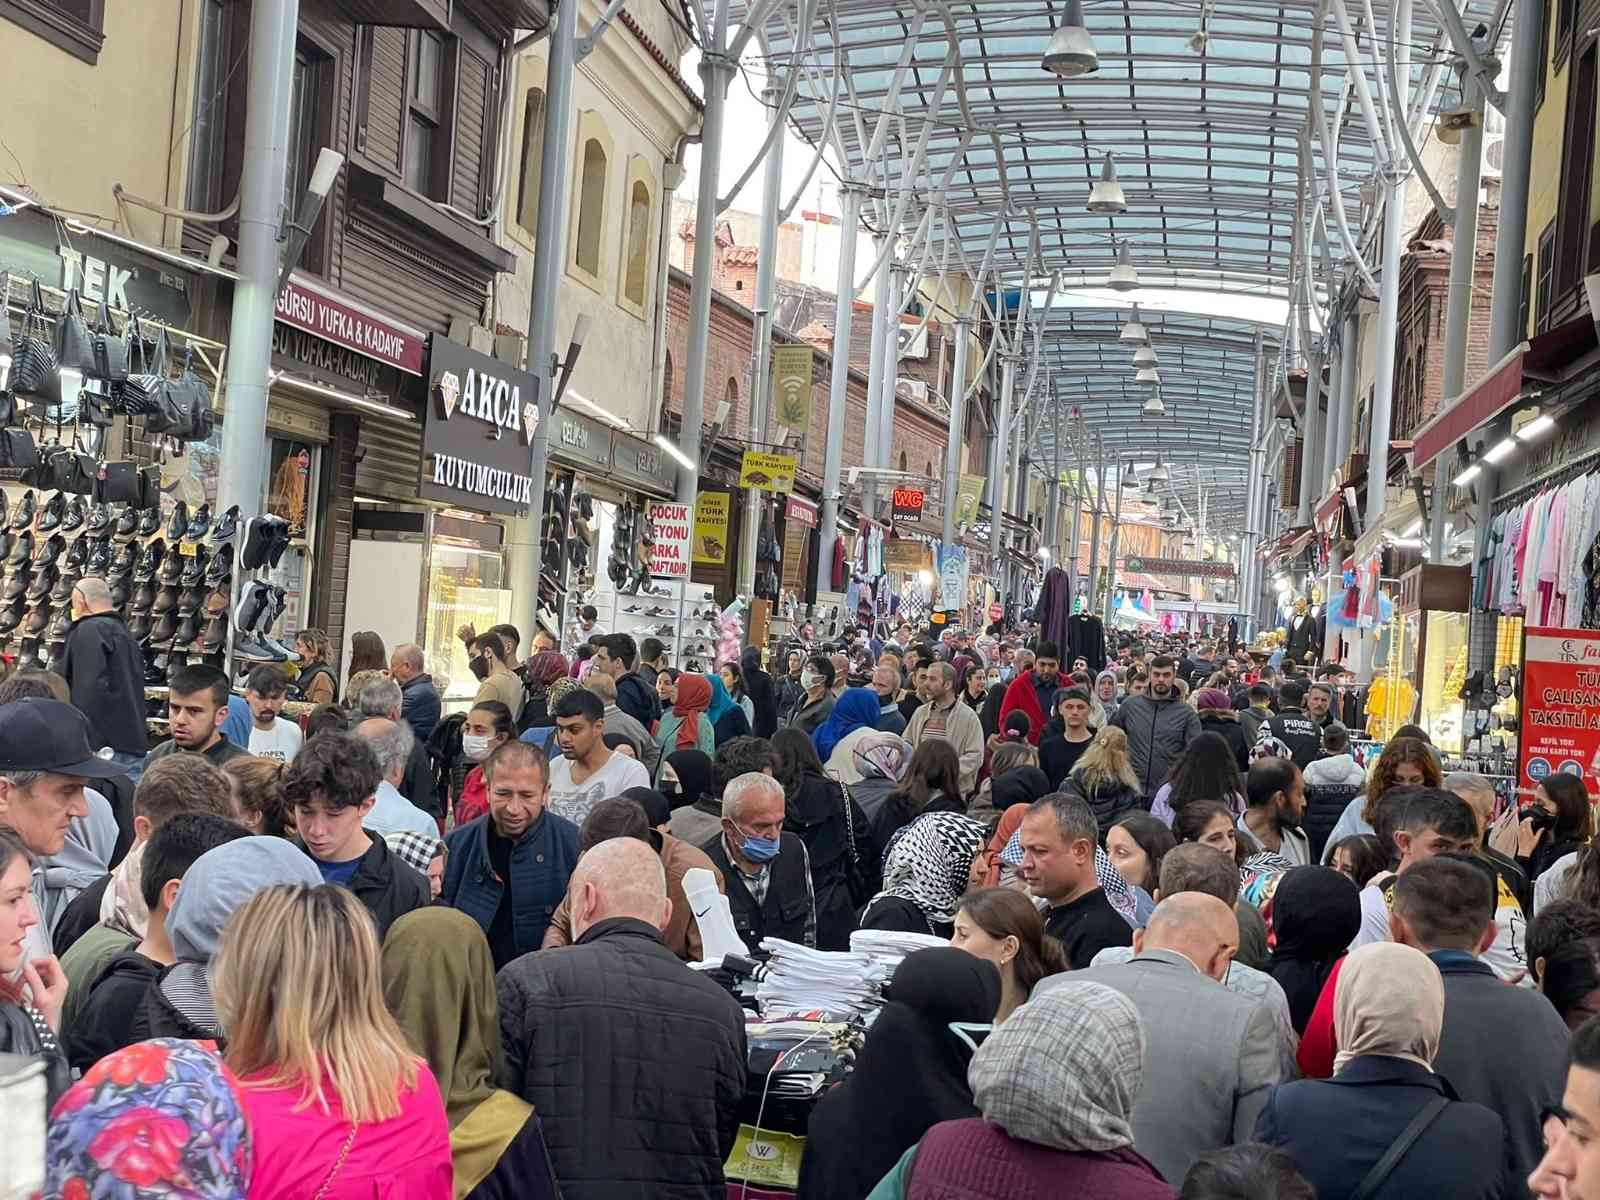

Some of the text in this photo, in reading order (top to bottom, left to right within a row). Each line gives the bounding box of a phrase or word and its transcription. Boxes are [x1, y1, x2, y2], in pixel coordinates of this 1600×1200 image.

[60, 246, 132, 312] TEK
[318, 303, 354, 342] YUFKA
[355, 320, 363, 346] &
[364, 323, 405, 361] KADAYIF
[460, 368, 521, 440] AKÇA
[433, 453, 533, 504] KUYUMCULUK
[894, 490, 923, 508] WC
[652, 525, 688, 540] EYONU
[649, 543, 680, 560] ARKA
[1580, 643, 1600, 661] fa
